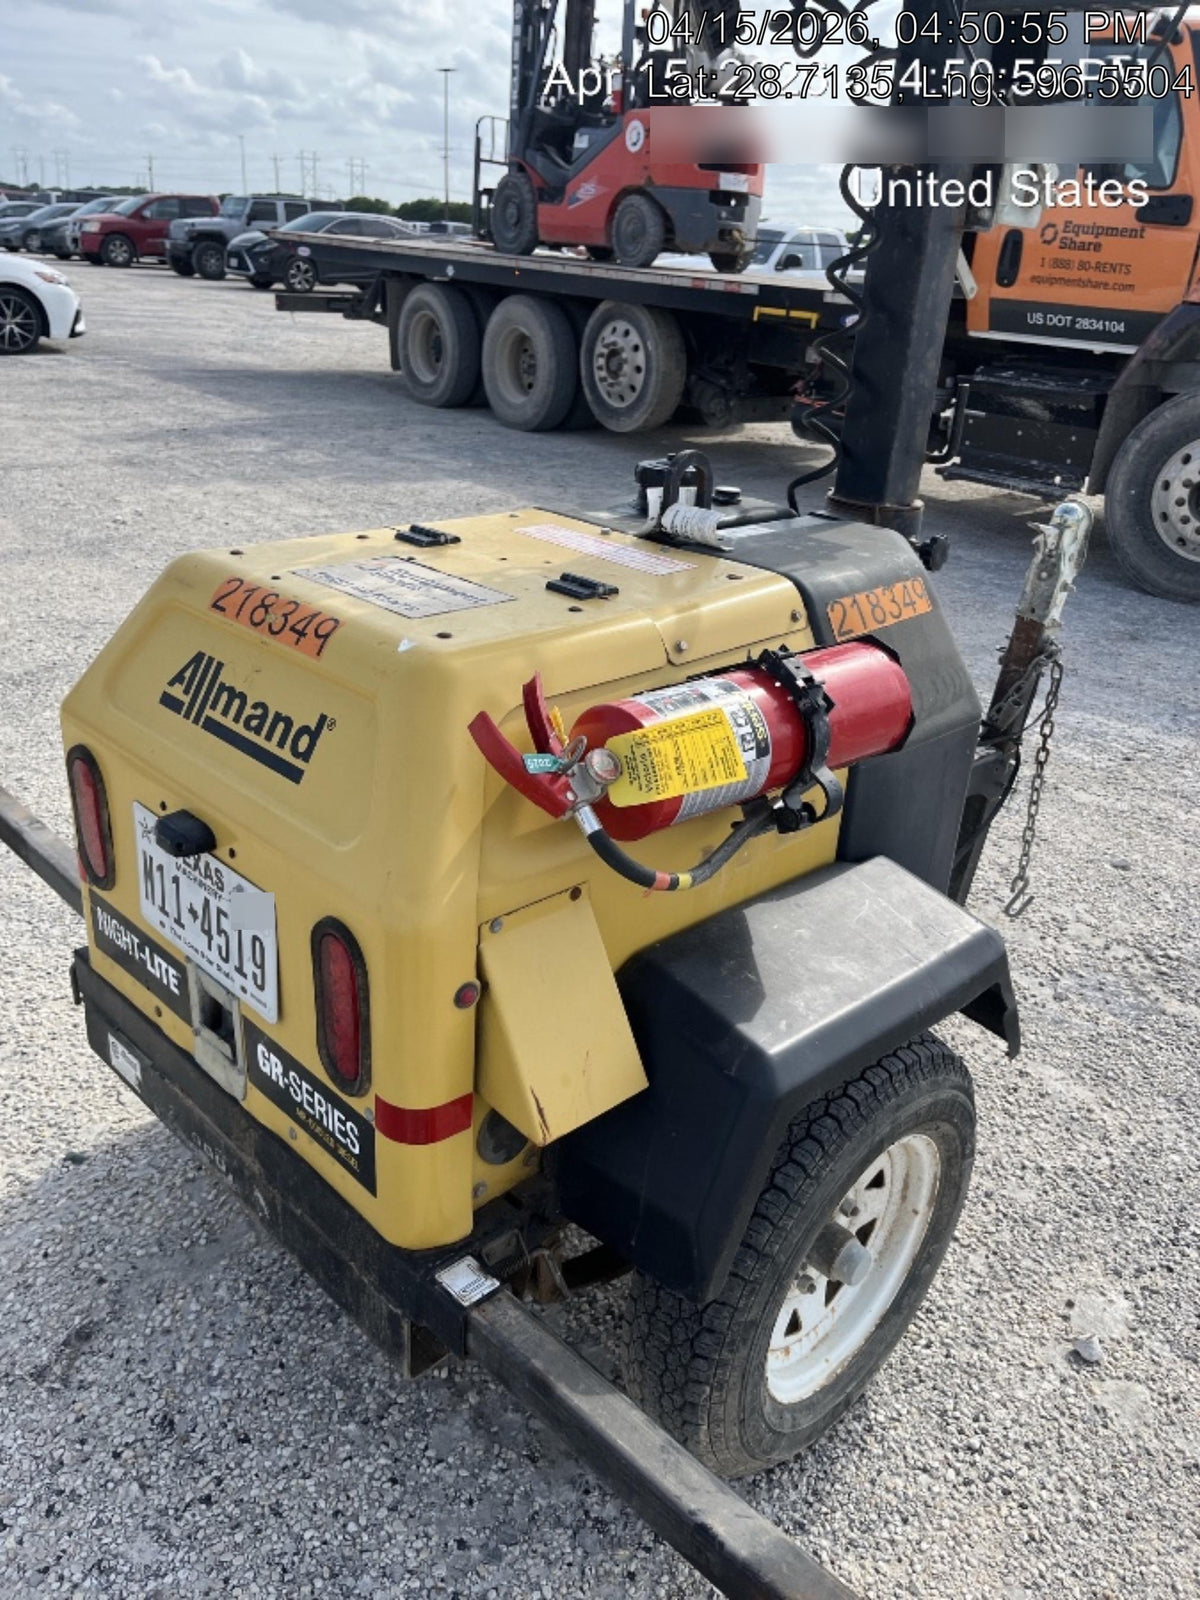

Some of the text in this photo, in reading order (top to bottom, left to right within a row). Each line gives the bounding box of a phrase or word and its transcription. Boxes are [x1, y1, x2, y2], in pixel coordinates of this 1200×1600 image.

[1062, 220, 1146, 239] Equipment
[1058, 236, 1102, 252] Share
[1077, 260, 1132, 275] 80-RENTS
[1029, 274, 1136, 292] equipmentshare.com
[1027, 312, 1126, 333] US DOT 2834104
[211, 577, 342, 657] 218349
[830, 578, 931, 637] 218349
[97, 906, 180, 997] NIGHT-LITE
[257, 1043, 360, 1155] GR-SERIES
